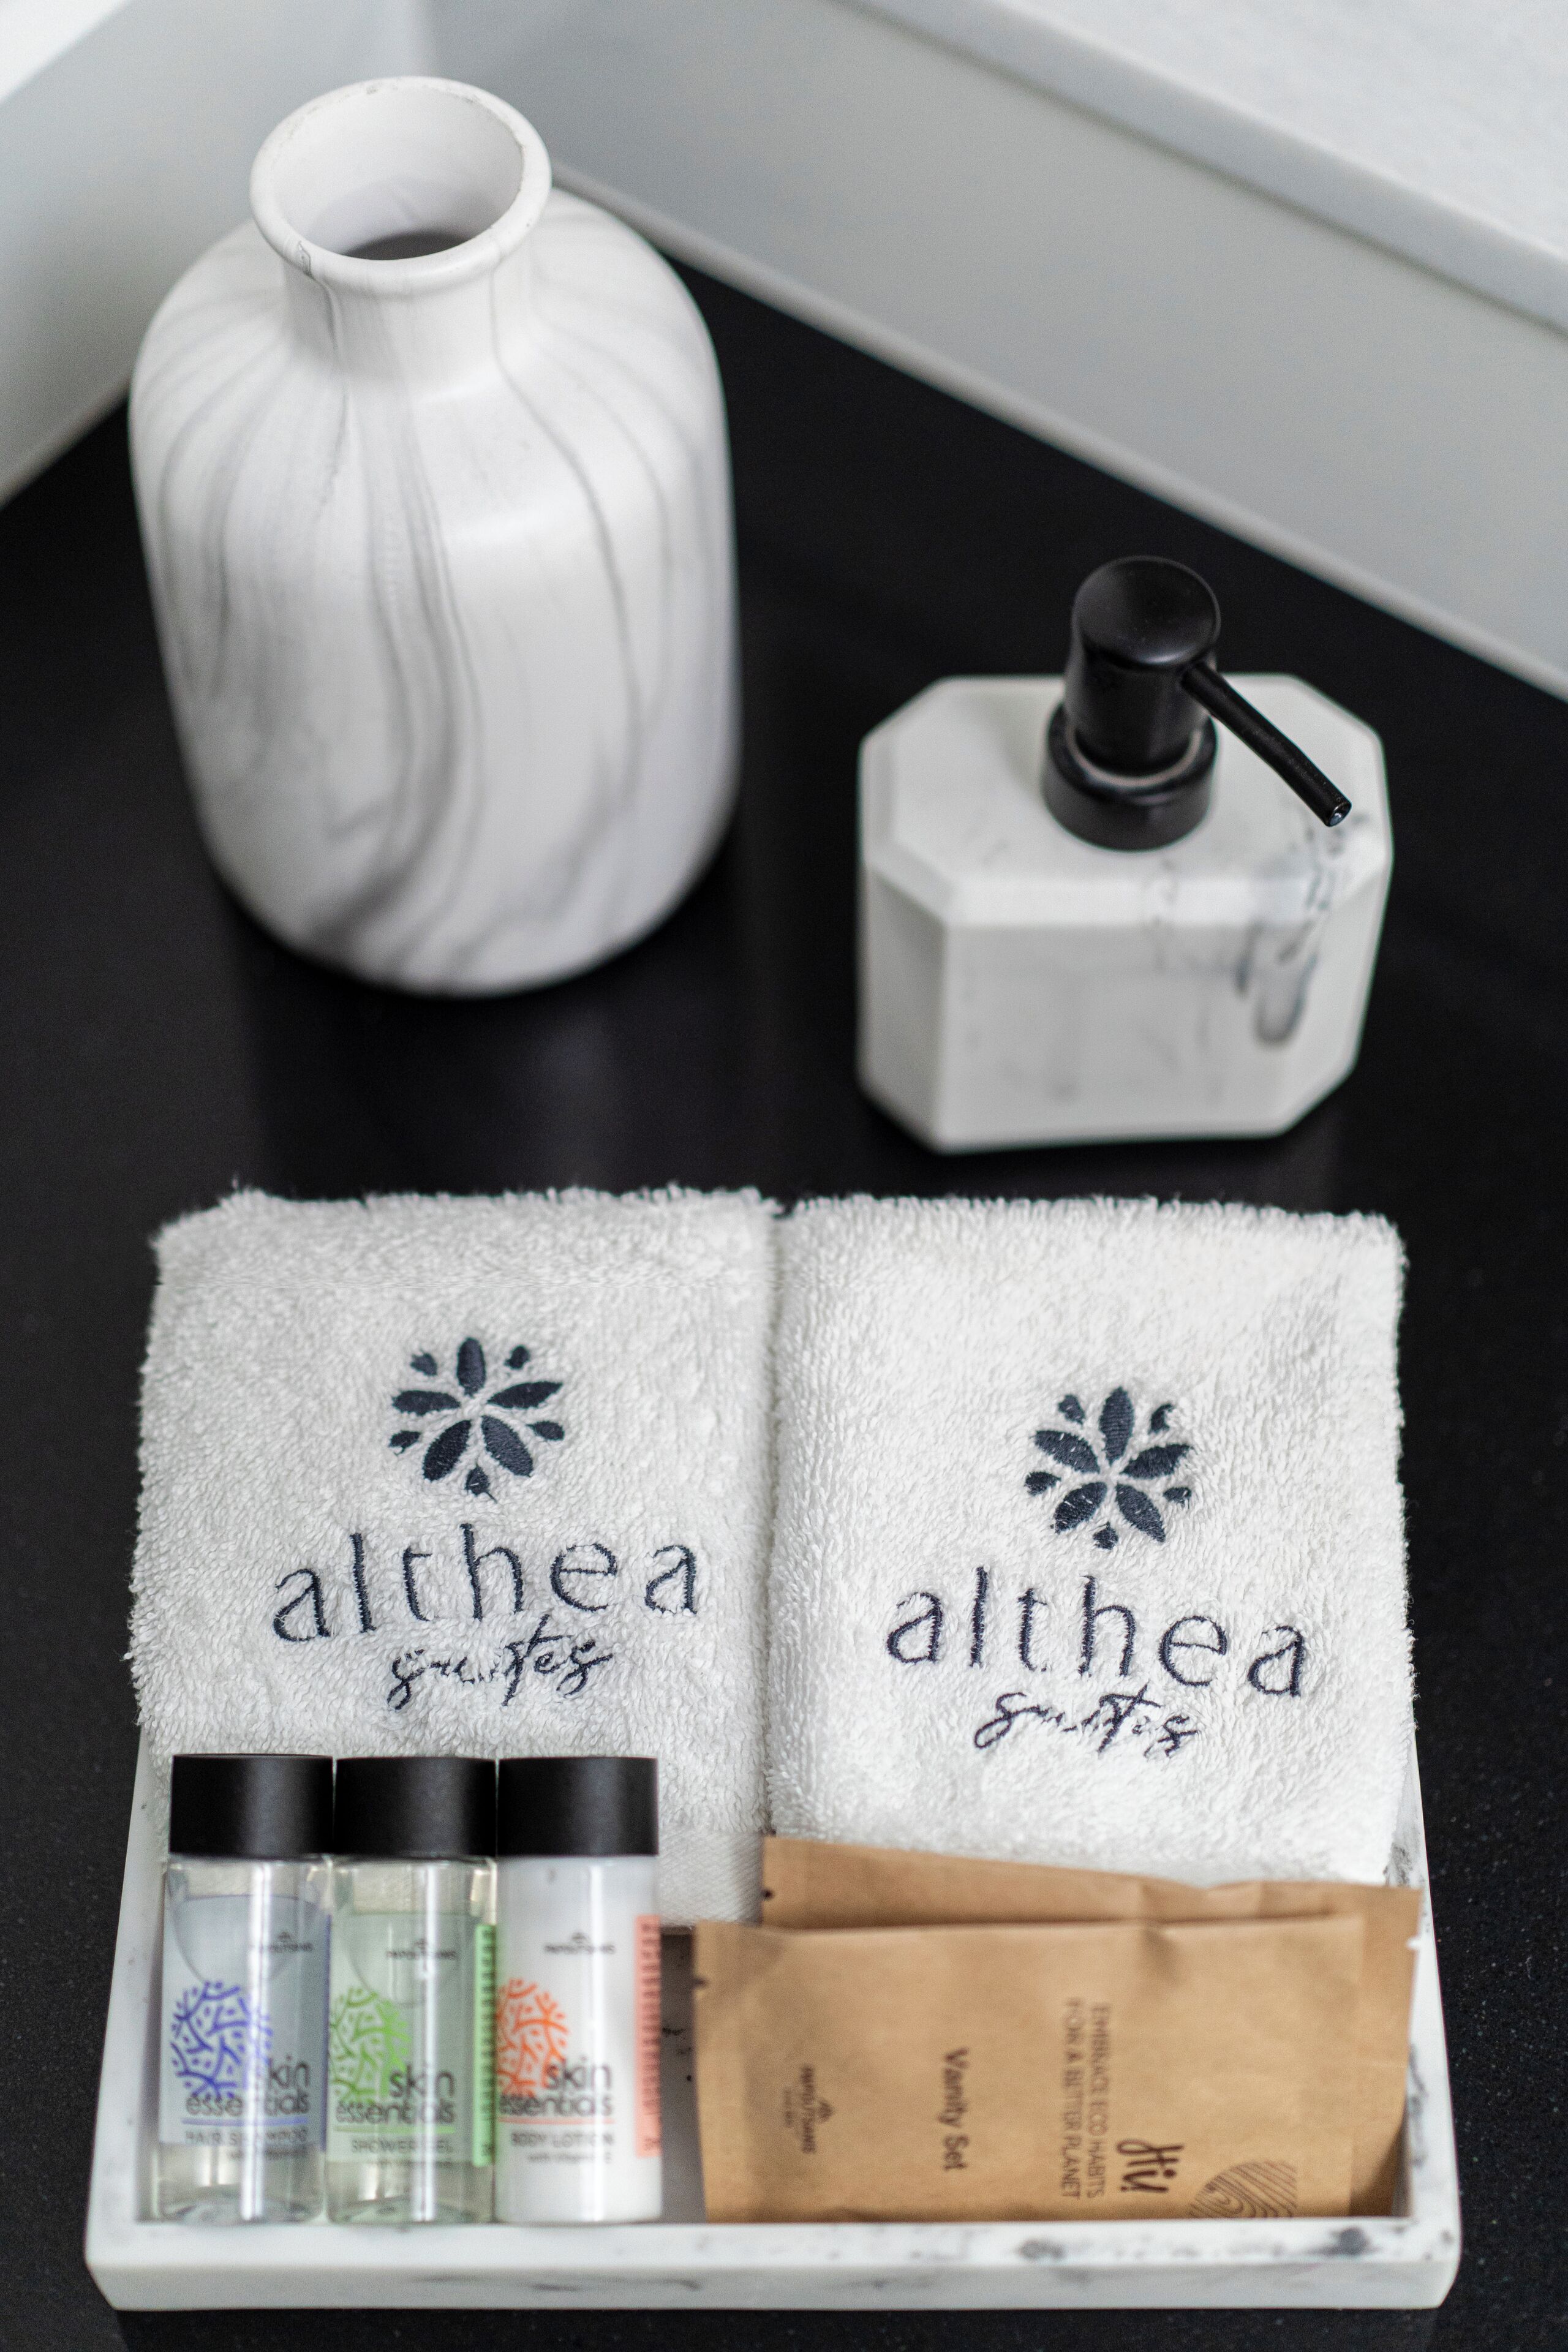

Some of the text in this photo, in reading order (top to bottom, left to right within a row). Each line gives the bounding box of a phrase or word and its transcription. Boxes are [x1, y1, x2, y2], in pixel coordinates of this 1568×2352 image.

[273, 1523, 698, 1642] althea
[887, 1566, 1306, 1697] althea
[546, 2054, 611, 2090] skin
[185, 2090, 310, 2116] essetials
[499, 2091, 612, 2116] essentias
[937, 2046, 970, 2171] Vanity Set
[1087, 2100, 1109, 2136] ECO
[1061, 2134, 1082, 2200] PLANET
[1086, 2139, 1106, 2199] HABITS
